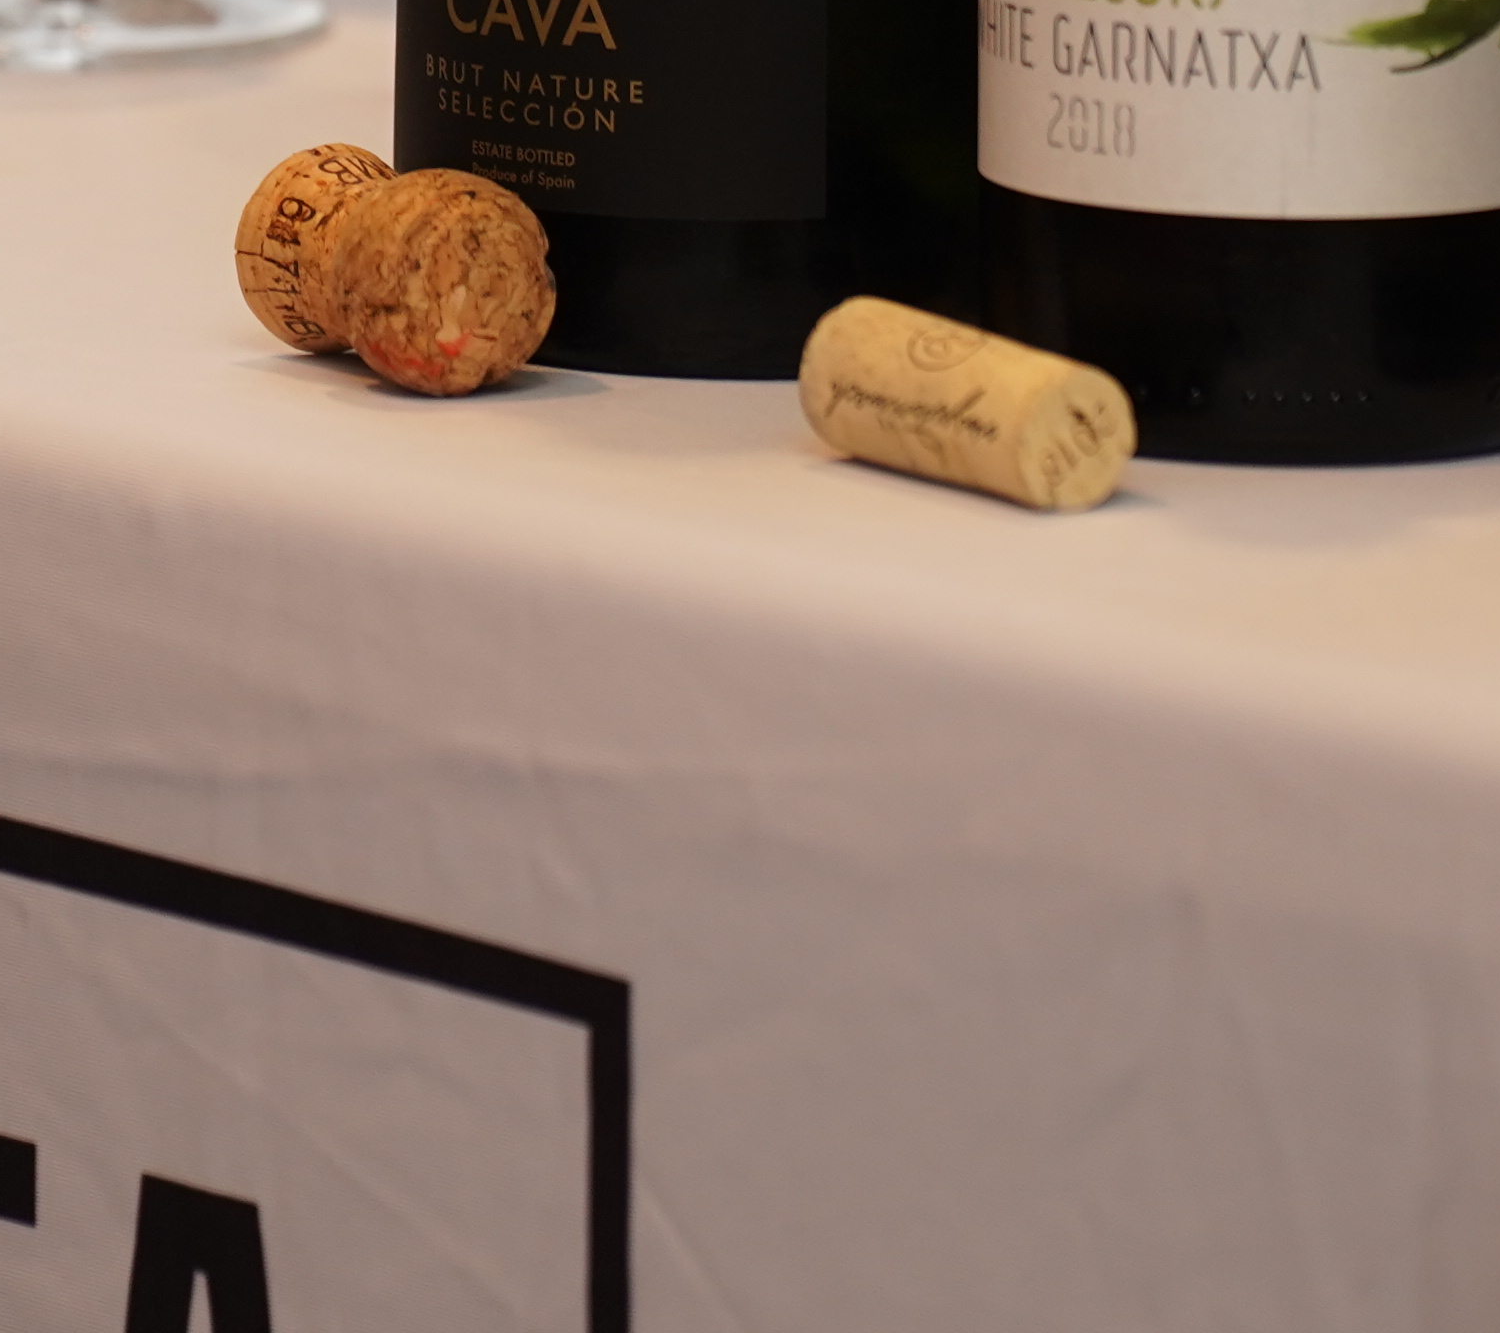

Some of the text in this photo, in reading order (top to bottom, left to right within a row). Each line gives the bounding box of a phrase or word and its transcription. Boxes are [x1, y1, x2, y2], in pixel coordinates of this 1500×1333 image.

[1052, 13, 1322, 92] GARNATXA
[425, 53, 646, 105] BRUT NATURE
[437, 88, 617, 134] SELECCIÓN
[1046, 92, 1137, 158] 2018
[471, 139, 576, 168] ESTATE BOTTLED
[521, 167, 535, 185] of
[537, 172, 576, 190] Spain
